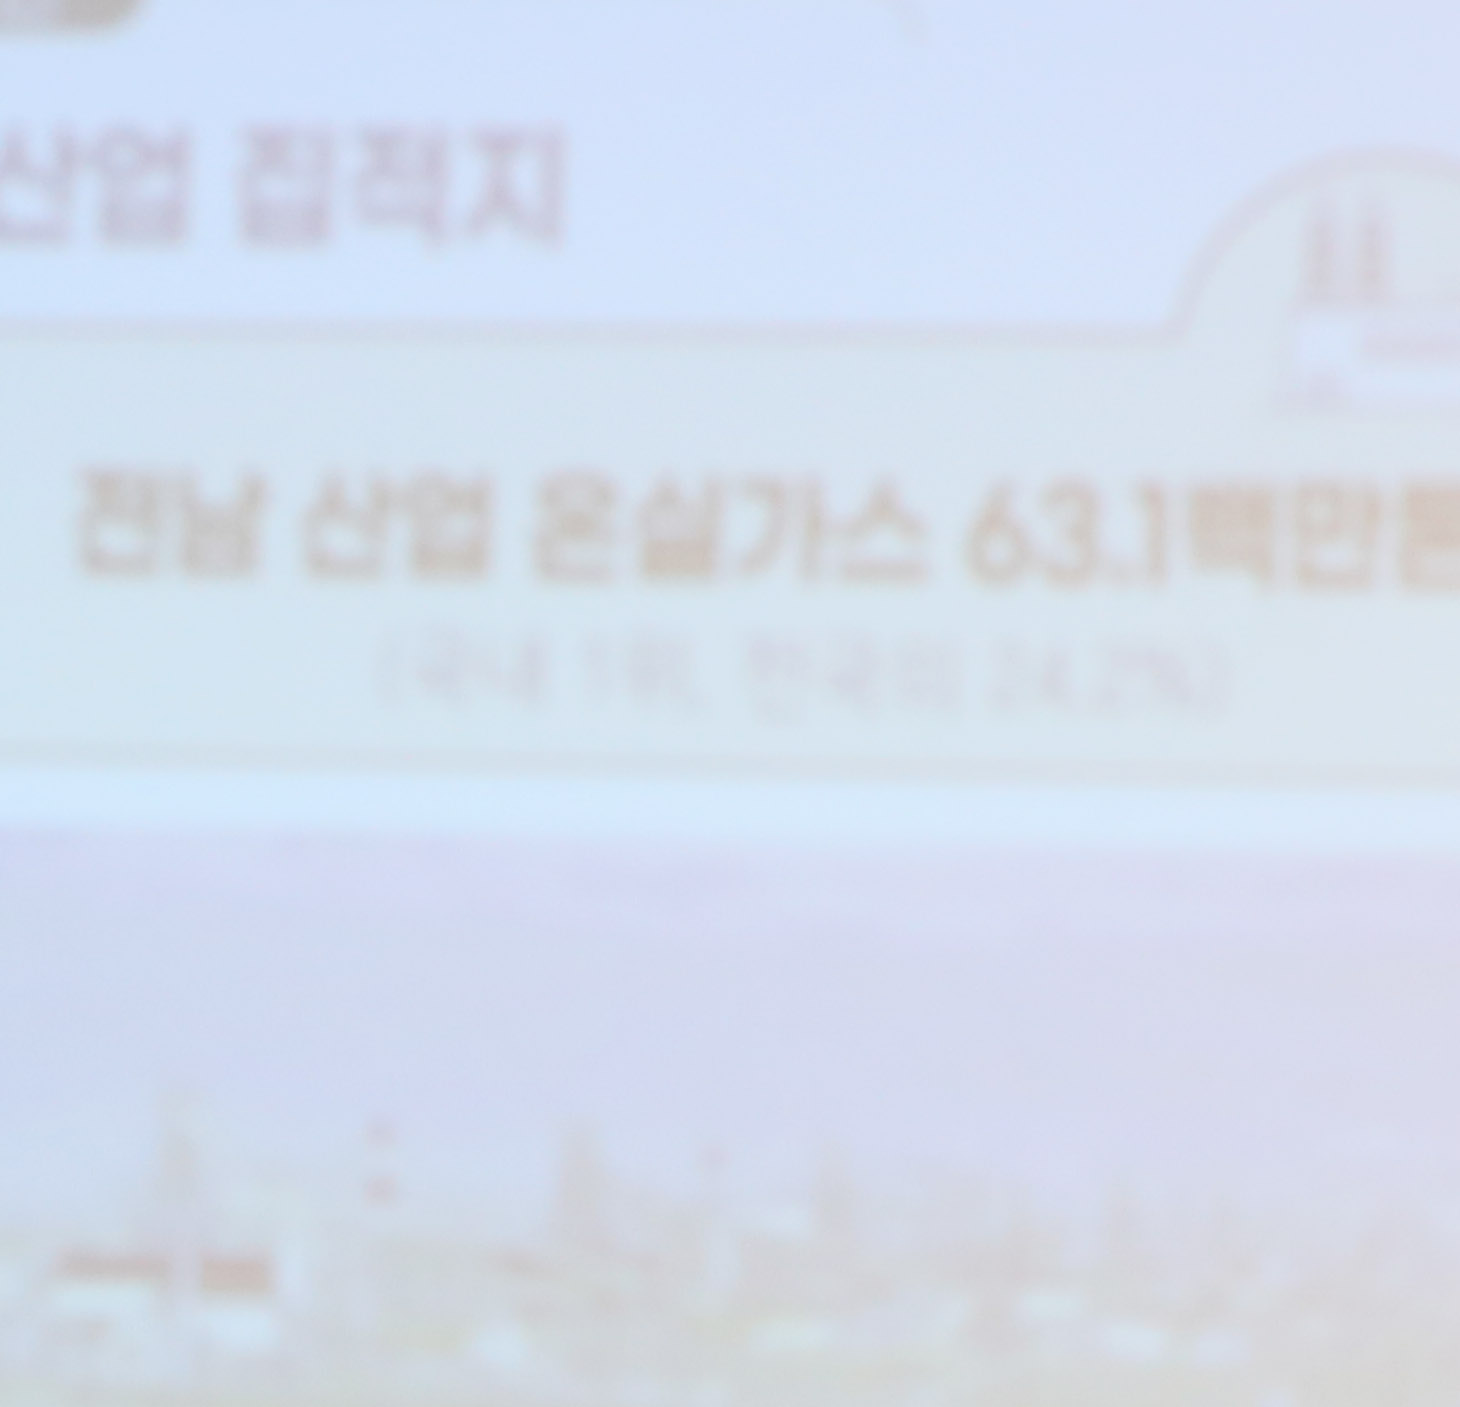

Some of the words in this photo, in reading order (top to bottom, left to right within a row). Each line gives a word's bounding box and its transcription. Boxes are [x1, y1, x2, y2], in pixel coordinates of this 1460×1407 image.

[235, 122, 569, 250] 집적지
[70, 463, 266, 581] 전남
[300, 465, 495, 584] 산업
[529, 471, 933, 588] 온실가스
